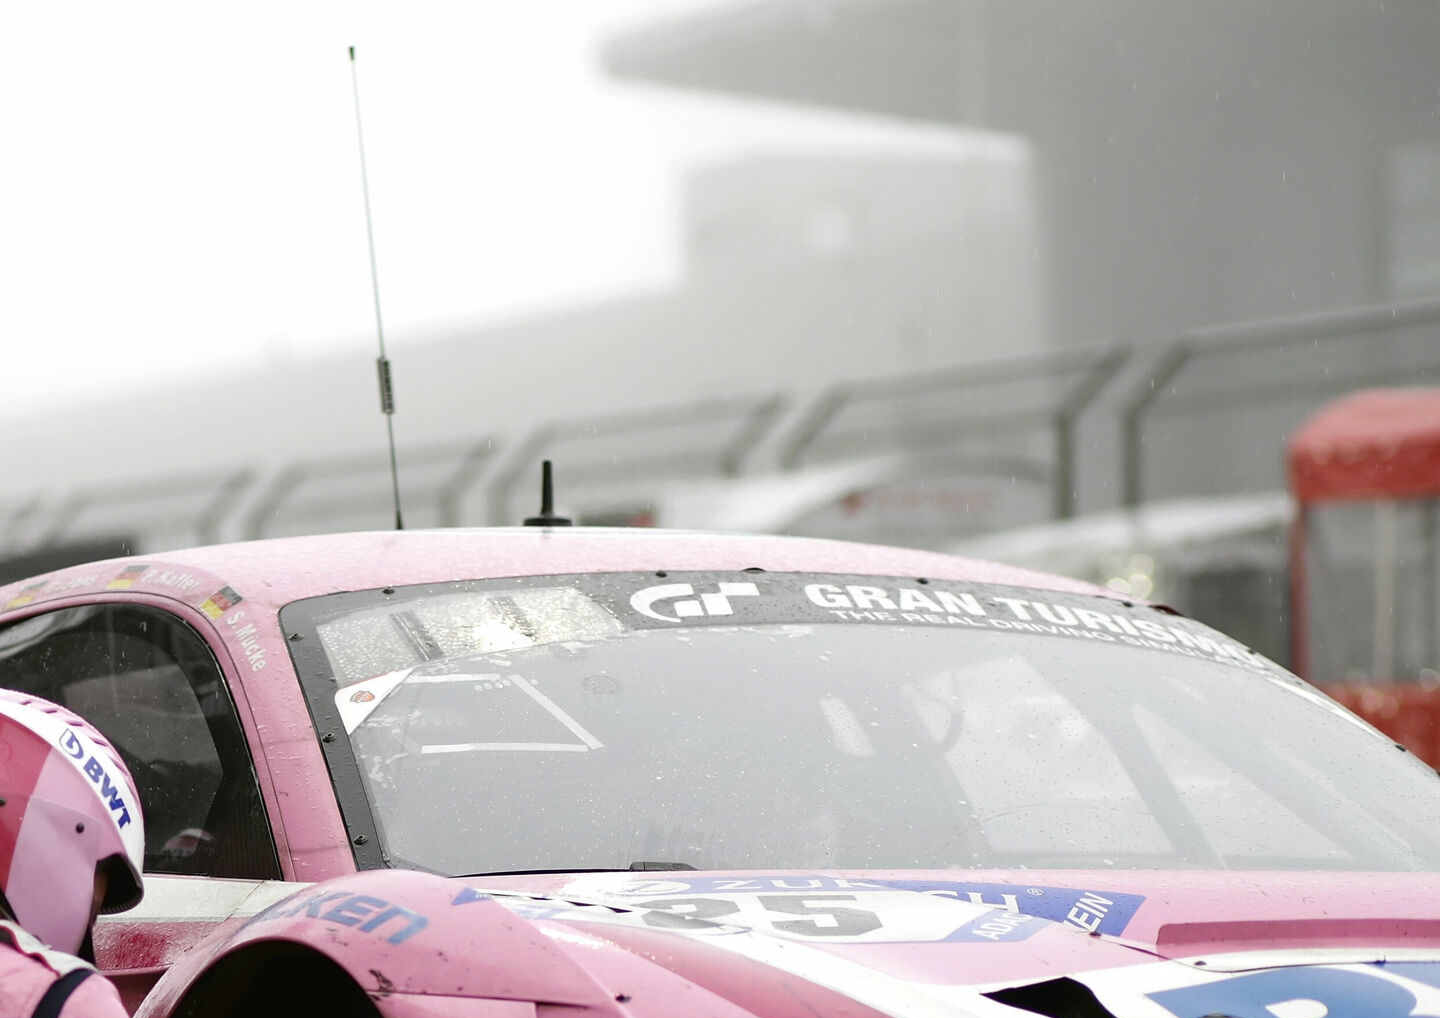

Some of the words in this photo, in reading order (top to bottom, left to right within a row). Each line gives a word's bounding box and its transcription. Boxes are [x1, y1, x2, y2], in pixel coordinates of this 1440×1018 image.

[803, 583, 987, 616] GRAN
[226, 610, 245, 629] S.
[829, 609, 896, 621] THE
[901, 612, 987, 627] REAL
[989, 619, 1117, 642] DRIVING
[235, 622, 267, 672] Mücke
[82, 756, 132, 829] BWT
